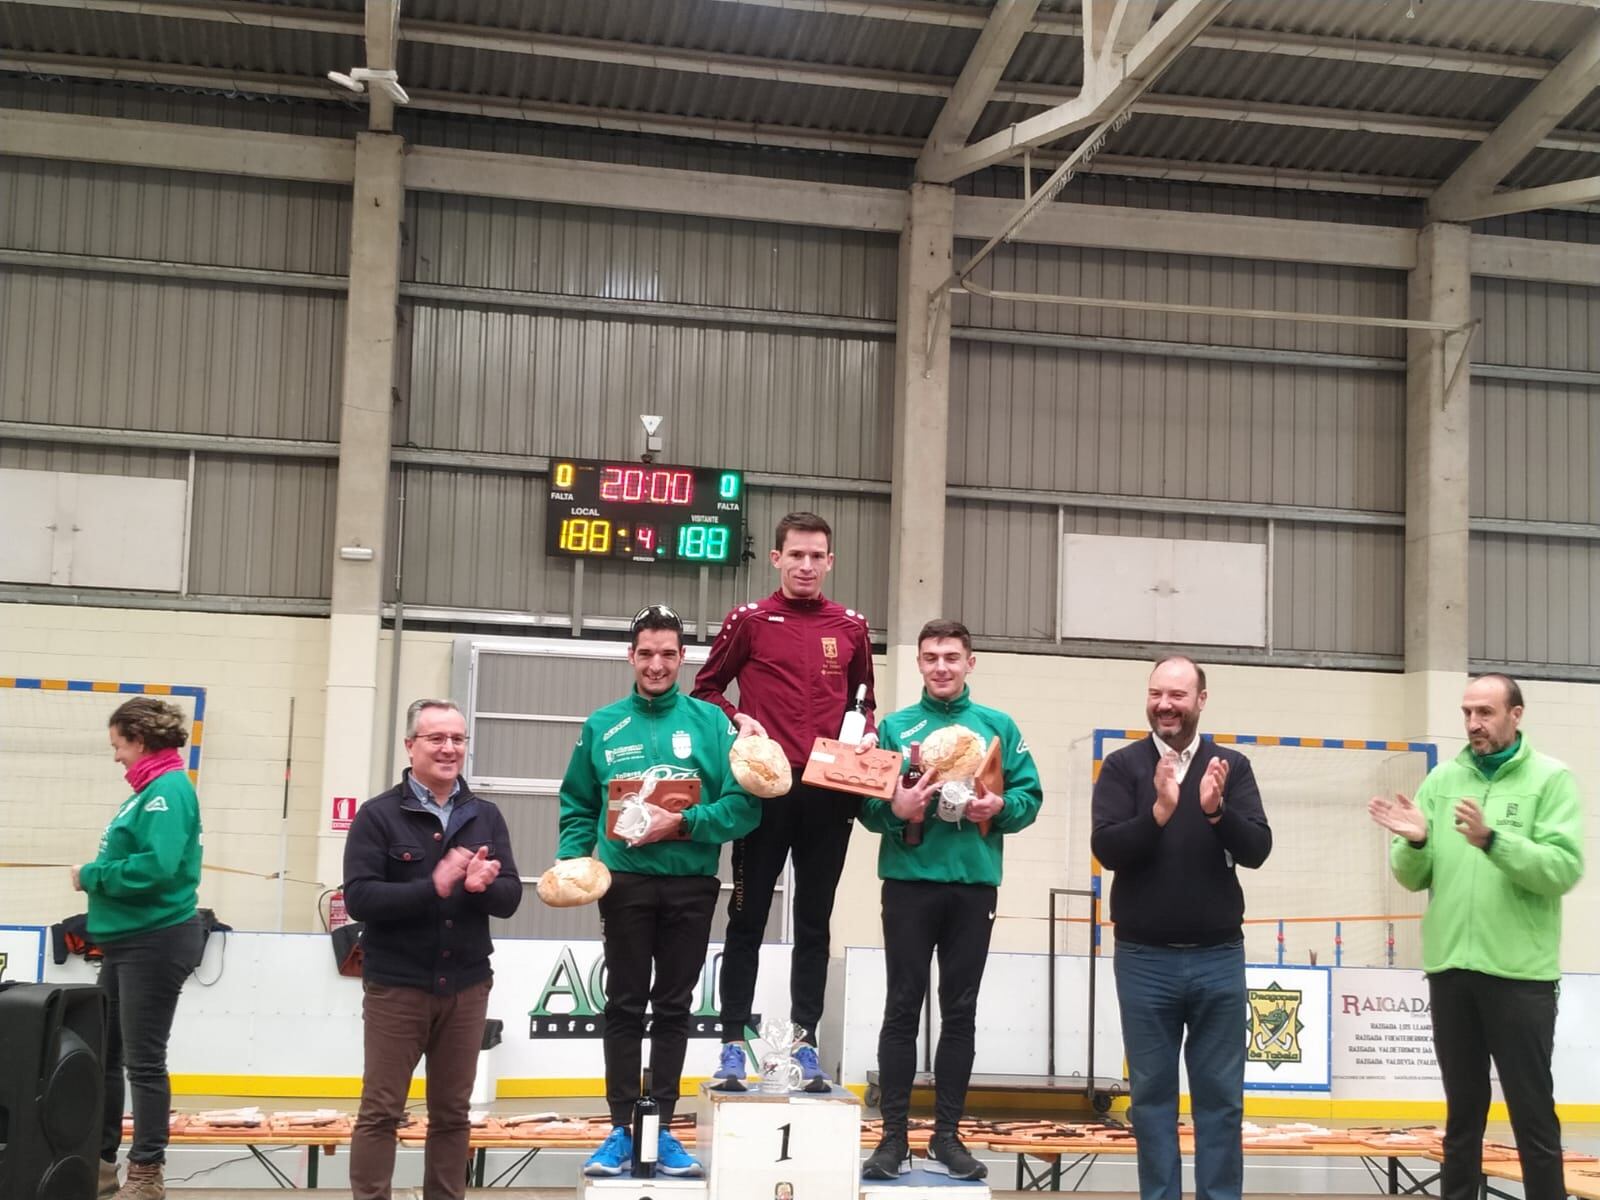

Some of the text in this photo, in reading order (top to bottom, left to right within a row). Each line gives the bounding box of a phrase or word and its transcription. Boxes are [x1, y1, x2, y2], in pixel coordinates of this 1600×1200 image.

[556, 464, 573, 487] 0
[602, 469, 691, 503] 20:00
[720, 474, 736, 497] 0
[551, 491, 574, 501] FALTA
[571, 507, 600, 516] LOCAL
[717, 502, 740, 511] FALTA
[691, 514, 719, 524] VISITANTE
[637, 528, 652, 549] 4
[1355, 1033, 1382, 1041] RAIGADA
[1348, 1045, 1376, 1053] RAIGADA
[1355, 1057, 1383, 1065] RAIGADA
[775, 1122, 793, 1163] 1
